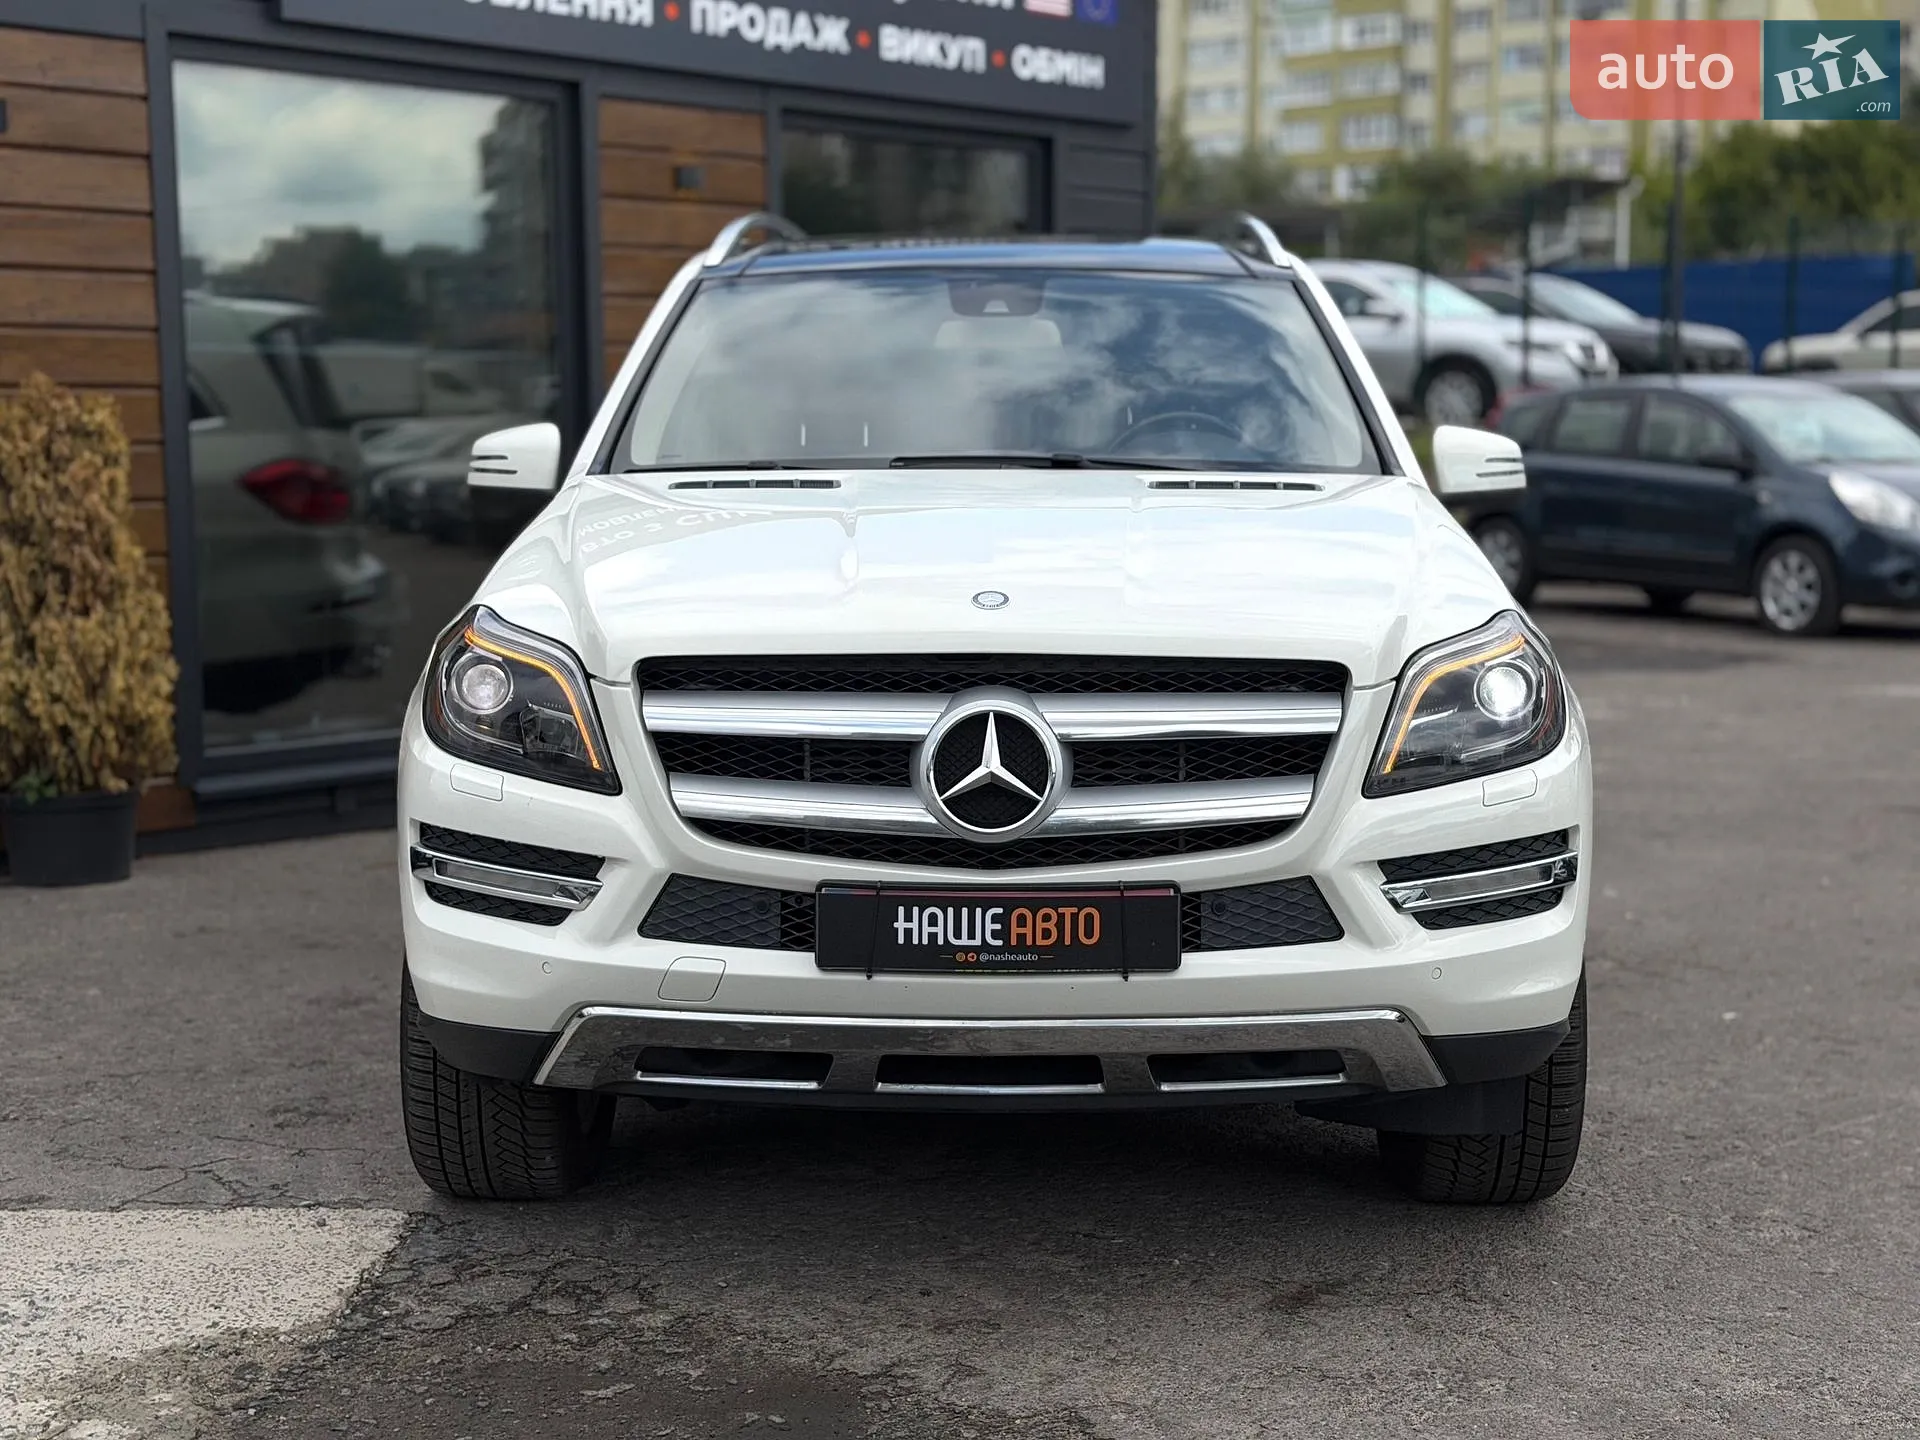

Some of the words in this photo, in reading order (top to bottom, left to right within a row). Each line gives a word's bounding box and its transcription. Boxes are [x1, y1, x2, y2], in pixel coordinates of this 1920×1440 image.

[690, 0, 851, 55] ПРОДАЖ
[878, 23, 987, 74] ВИКУП
[1011, 43, 1105, 90] ОБМІН
[893, 906, 1004, 946] НАШЕ
[1010, 906, 1101, 946] АВТО
[979, 952, 1039, 962] @nasheauto
